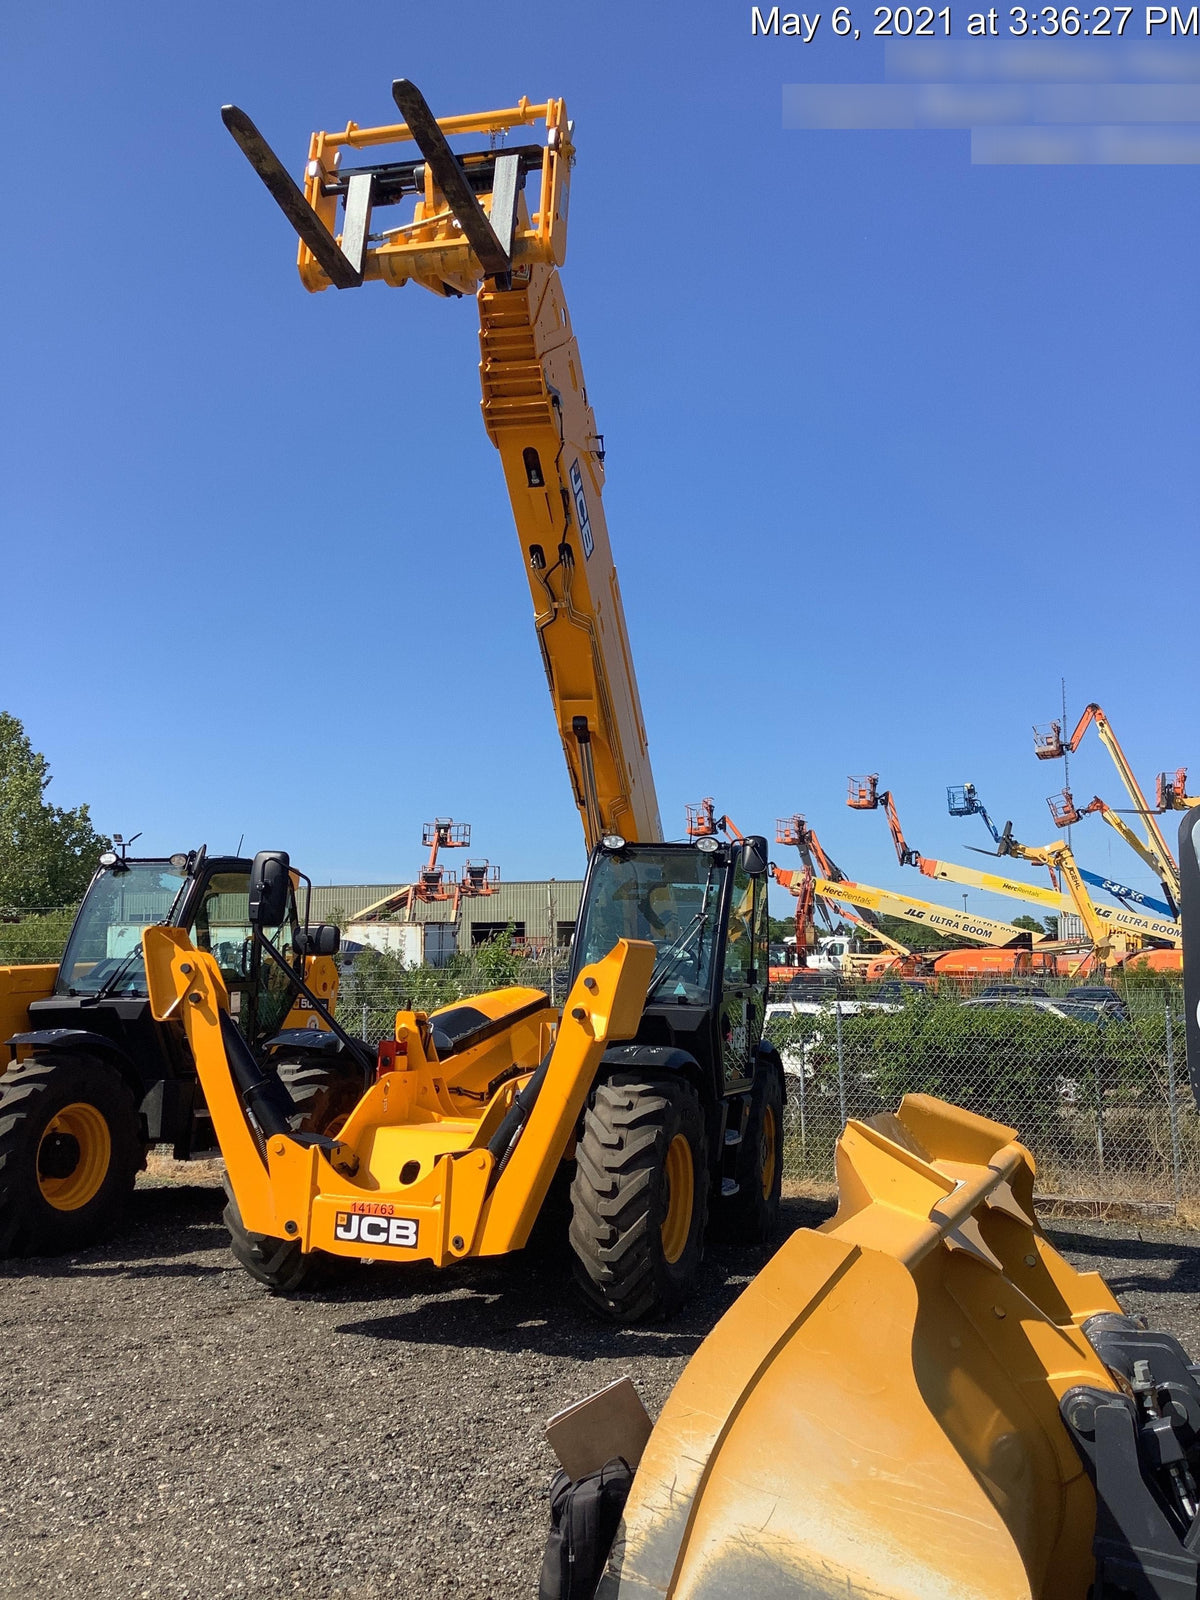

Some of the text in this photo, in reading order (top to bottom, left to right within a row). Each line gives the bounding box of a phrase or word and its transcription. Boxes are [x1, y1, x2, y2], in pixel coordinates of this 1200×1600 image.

[569, 458, 595, 561] JCB
[904, 908, 926, 919] JLG
[929, 914, 960, 930] ULTRA
[961, 923, 993, 939] BOOM
[1116, 913, 1148, 929] ULTRA
[351, 1202, 395, 1216] 141763
[336, 1215, 417, 1247] JCB
